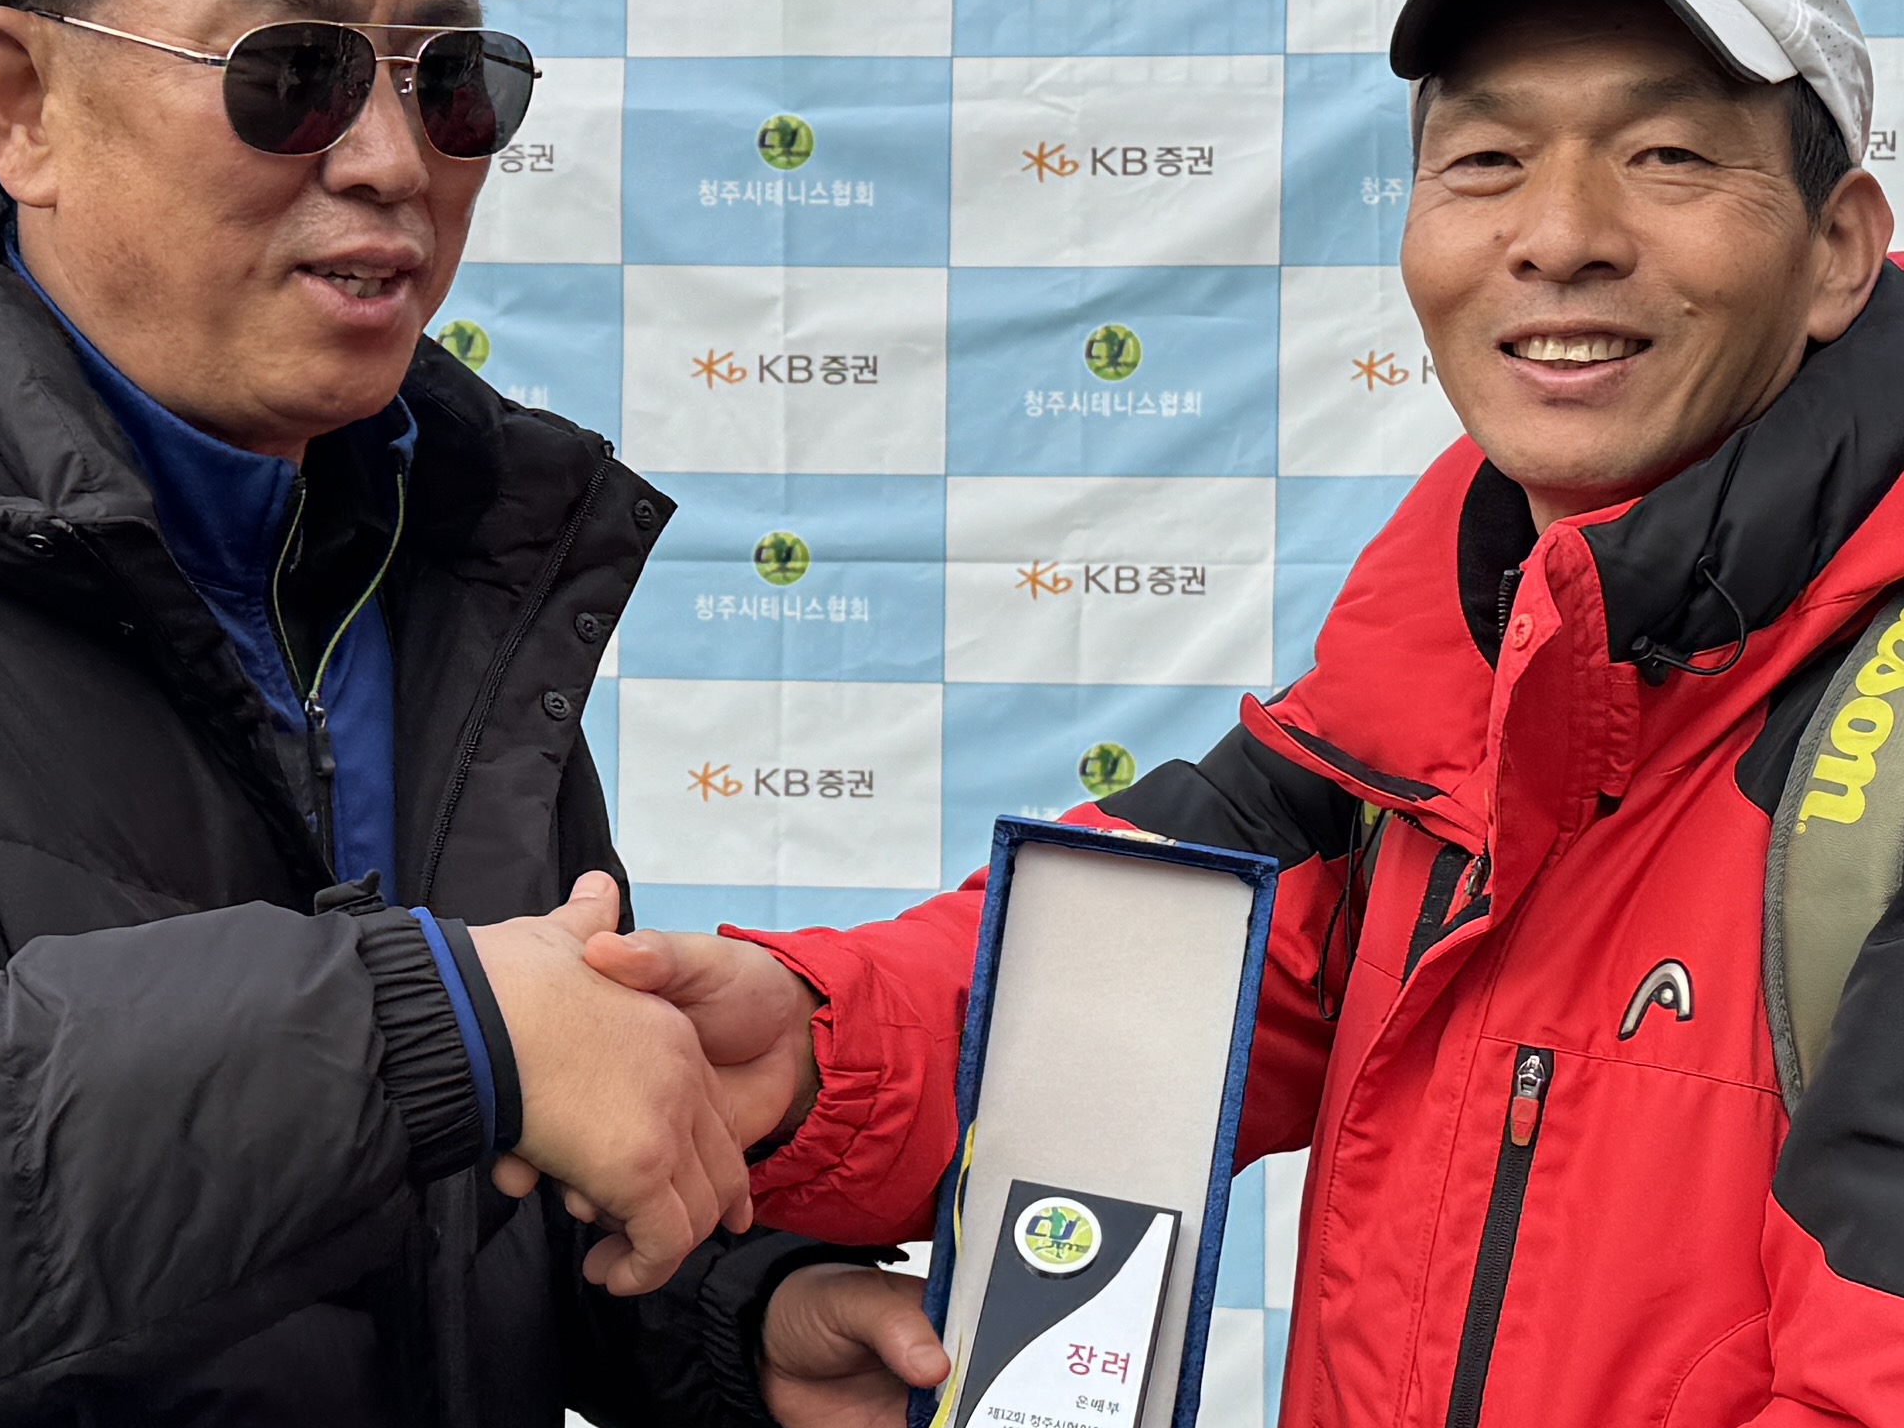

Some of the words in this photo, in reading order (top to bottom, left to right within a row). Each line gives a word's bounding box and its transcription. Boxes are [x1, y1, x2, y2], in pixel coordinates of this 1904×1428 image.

[698, 179, 874, 207] 청주시테니스협회
[1024, 390, 1202, 417] 청주시테니스협회
[694, 595, 869, 622] 청주시테니스협회
[1066, 1343, 1131, 1384] 장려
